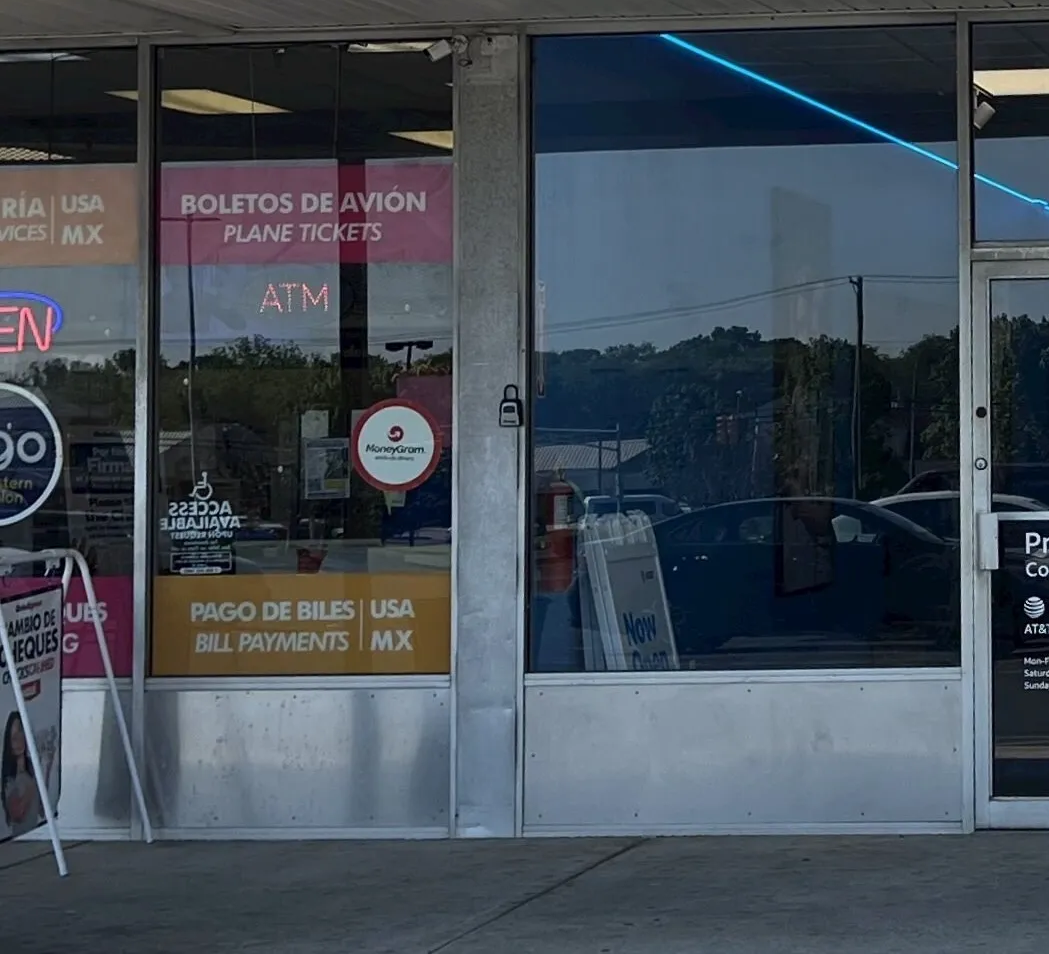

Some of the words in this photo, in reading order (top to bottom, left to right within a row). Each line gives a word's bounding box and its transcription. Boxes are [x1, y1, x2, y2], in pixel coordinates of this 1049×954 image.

[2, 191, 46, 218] RÍA
[61, 194, 104, 214] USA
[181, 193, 293, 215] BOLETOS
[301, 193, 333, 213] DE
[340, 184, 427, 213] AVIÓN
[61, 223, 103, 245] MX
[223, 224, 293, 243] PLANE
[299, 222, 382, 242] TICKETS
[257, 283, 329, 313] ATM
[365, 443, 425, 455] MoneyGram
[63, 602, 108, 623] UES
[191, 602, 256, 622] PAGO
[261, 602, 293, 622] DE
[297, 600, 355, 621] BILES
[370, 599, 415, 619] USA
[6, 613, 42, 638] AMBIO
[43, 609, 56, 628] DE
[195, 634, 234, 653] BILL
[238, 632, 350, 652] PAYMENTS
[370, 630, 414, 651] MX
